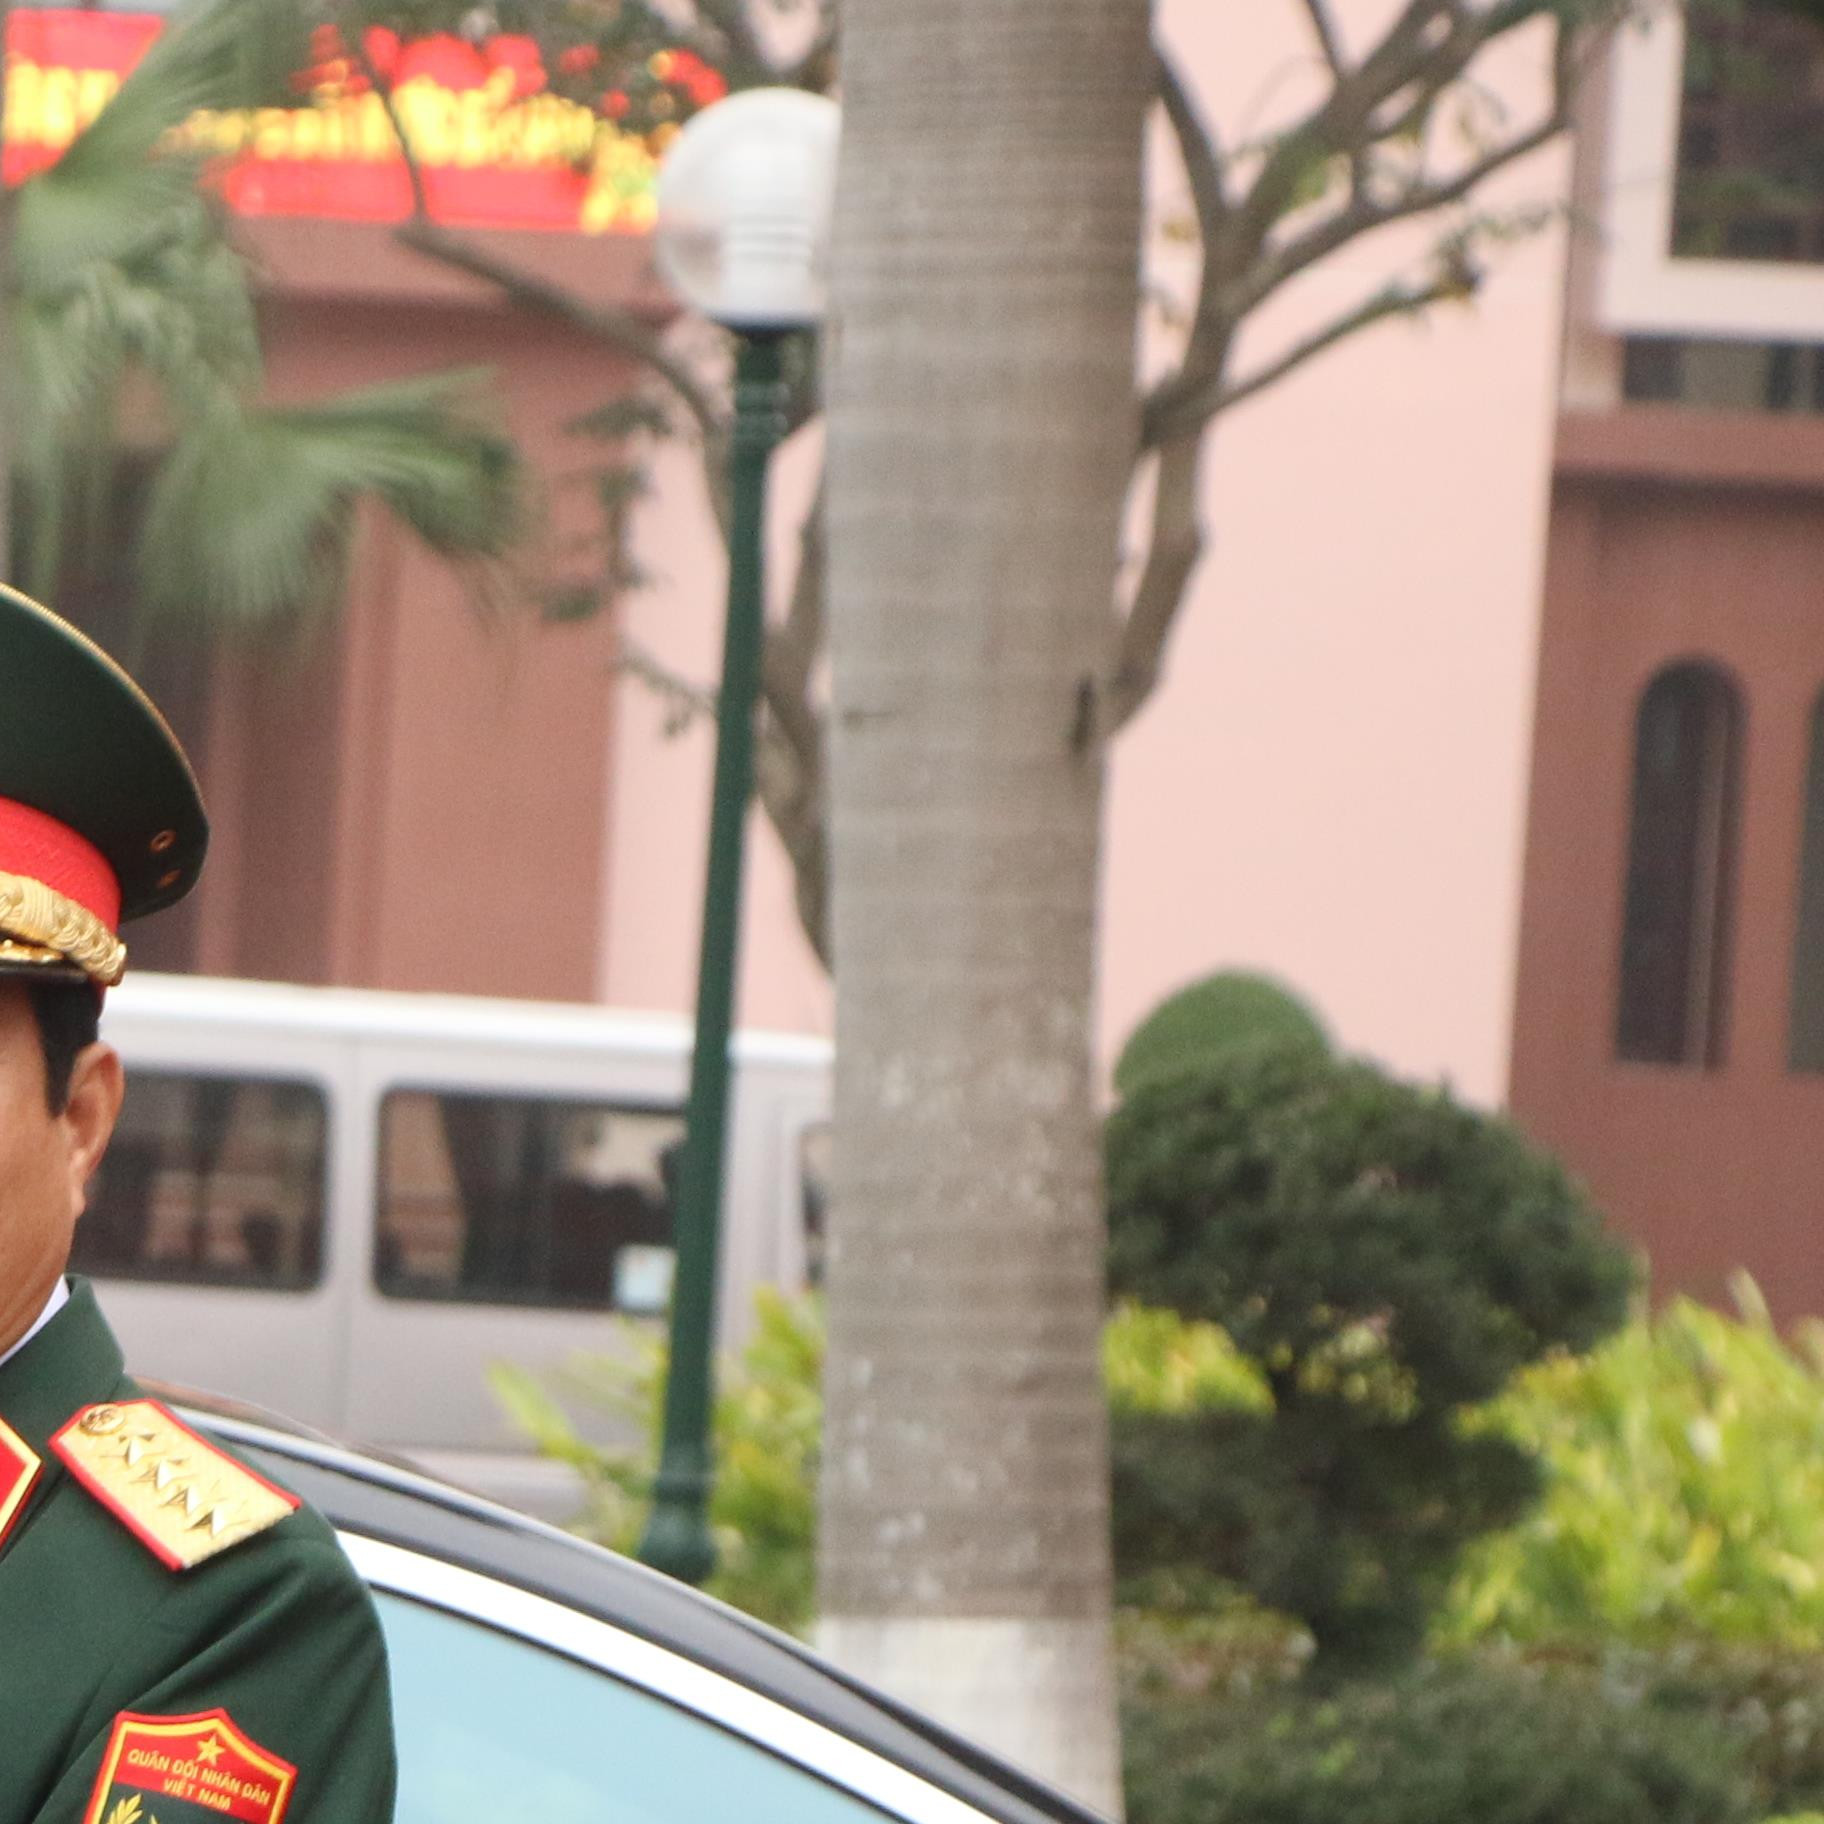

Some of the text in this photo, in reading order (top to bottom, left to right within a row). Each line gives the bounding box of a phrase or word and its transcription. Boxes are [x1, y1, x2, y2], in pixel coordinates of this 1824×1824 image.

[127, 1748, 171, 1772] QUÂN
[200, 1767, 242, 1794] NHÂN
[163, 1777, 232, 1811] VIỆT NAM
